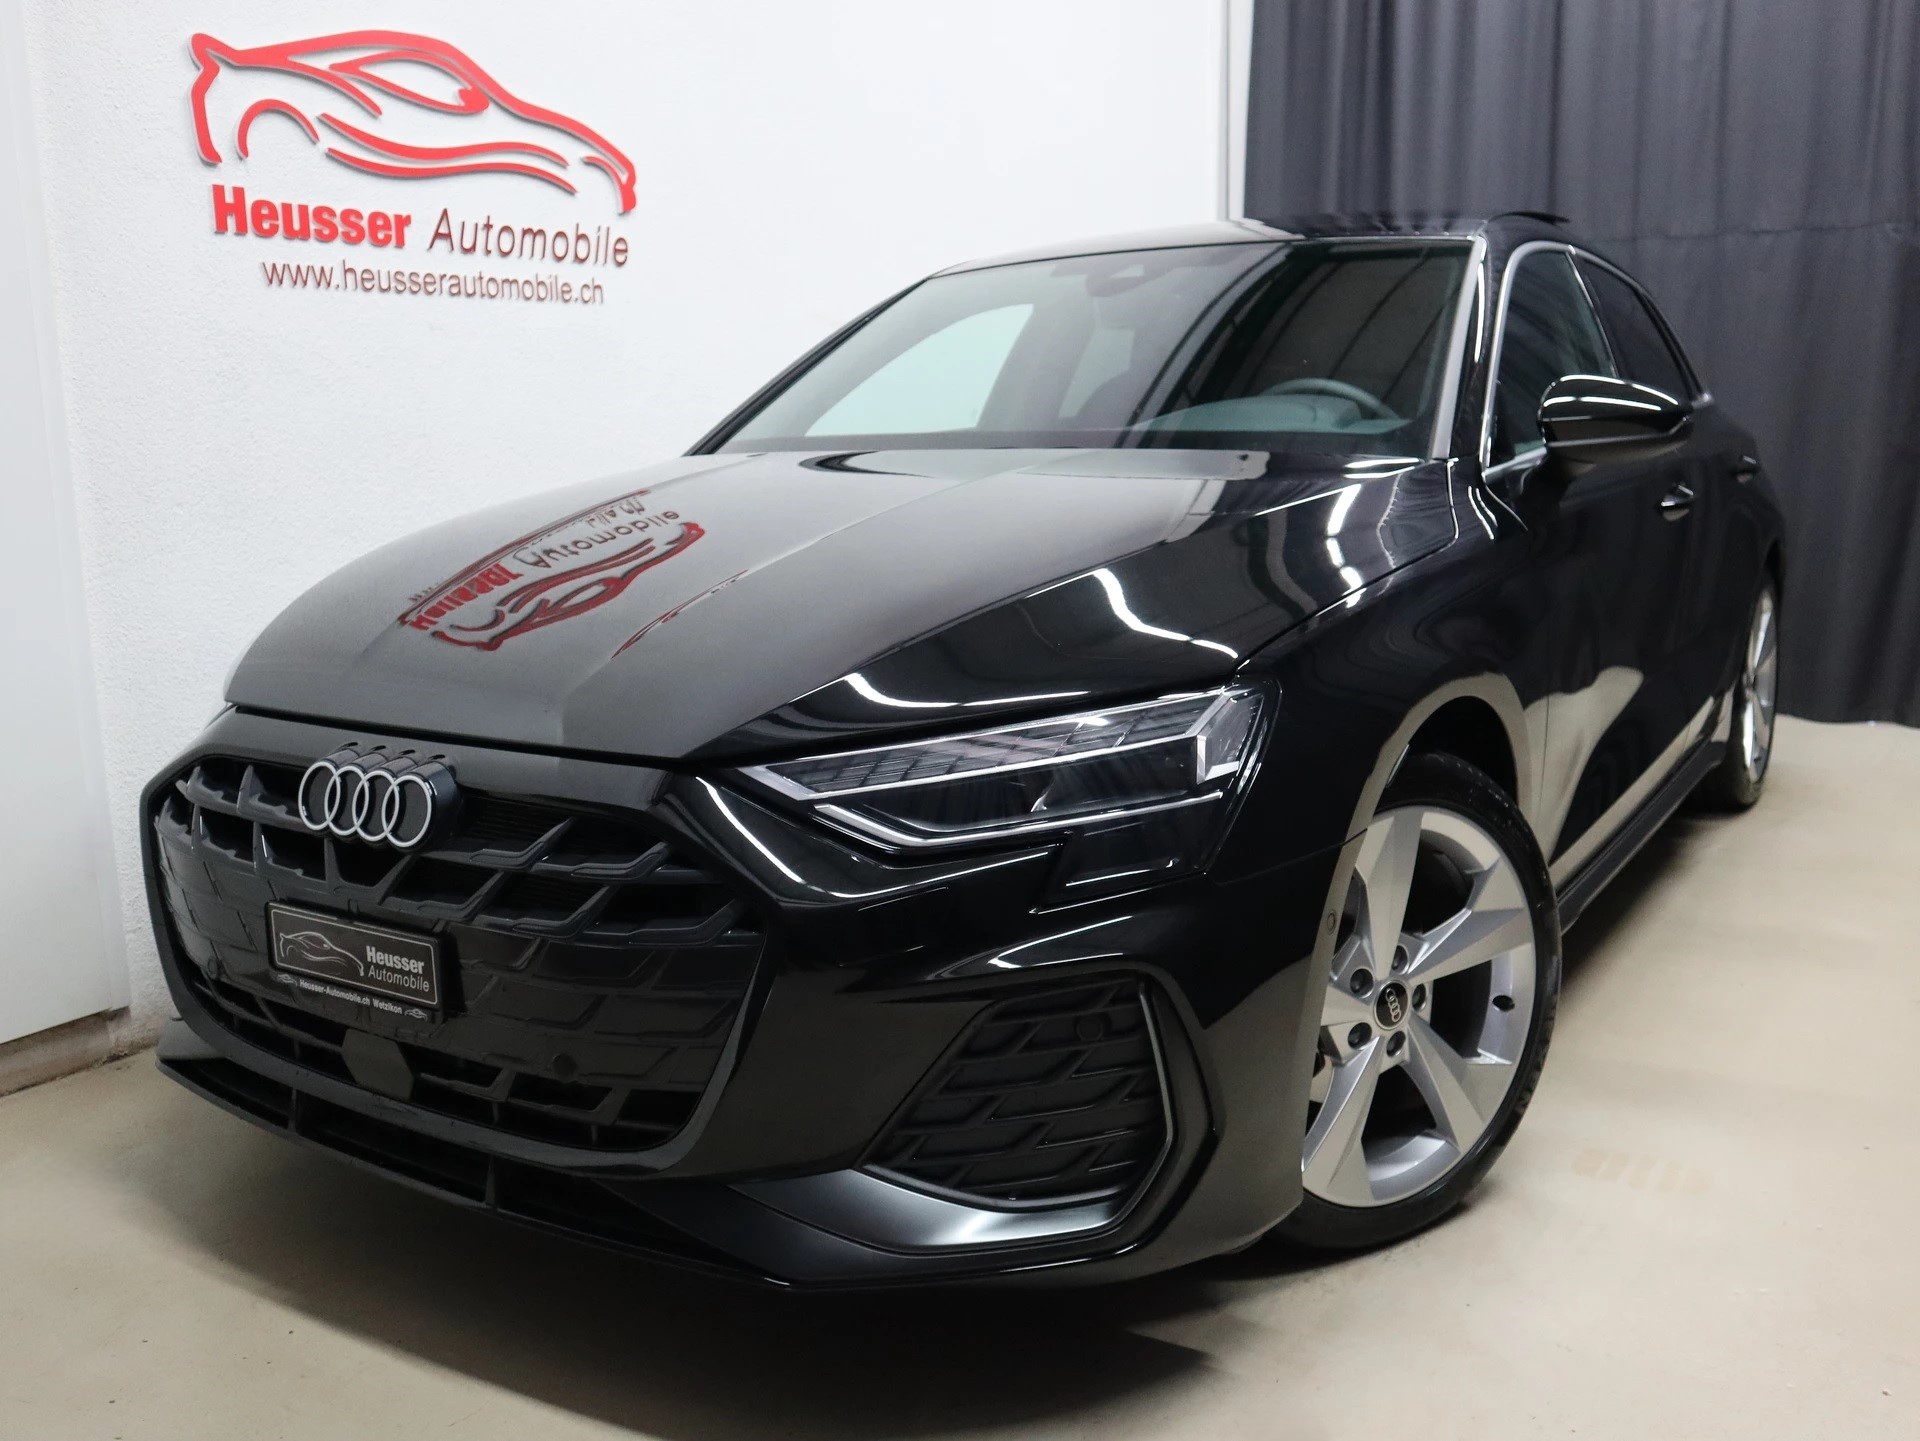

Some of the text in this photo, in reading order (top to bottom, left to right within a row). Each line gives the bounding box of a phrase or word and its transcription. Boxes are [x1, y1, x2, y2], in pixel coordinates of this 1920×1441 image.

[211, 184, 629, 267] Heusser Automobile
[262, 260, 604, 305] www.heusserautomobile.ch
[366, 945, 425, 974] Heusser
[300, 979, 402, 1014] Heusser-Automobile.ch Wetzikon
[368, 966, 429, 992] Automobile
